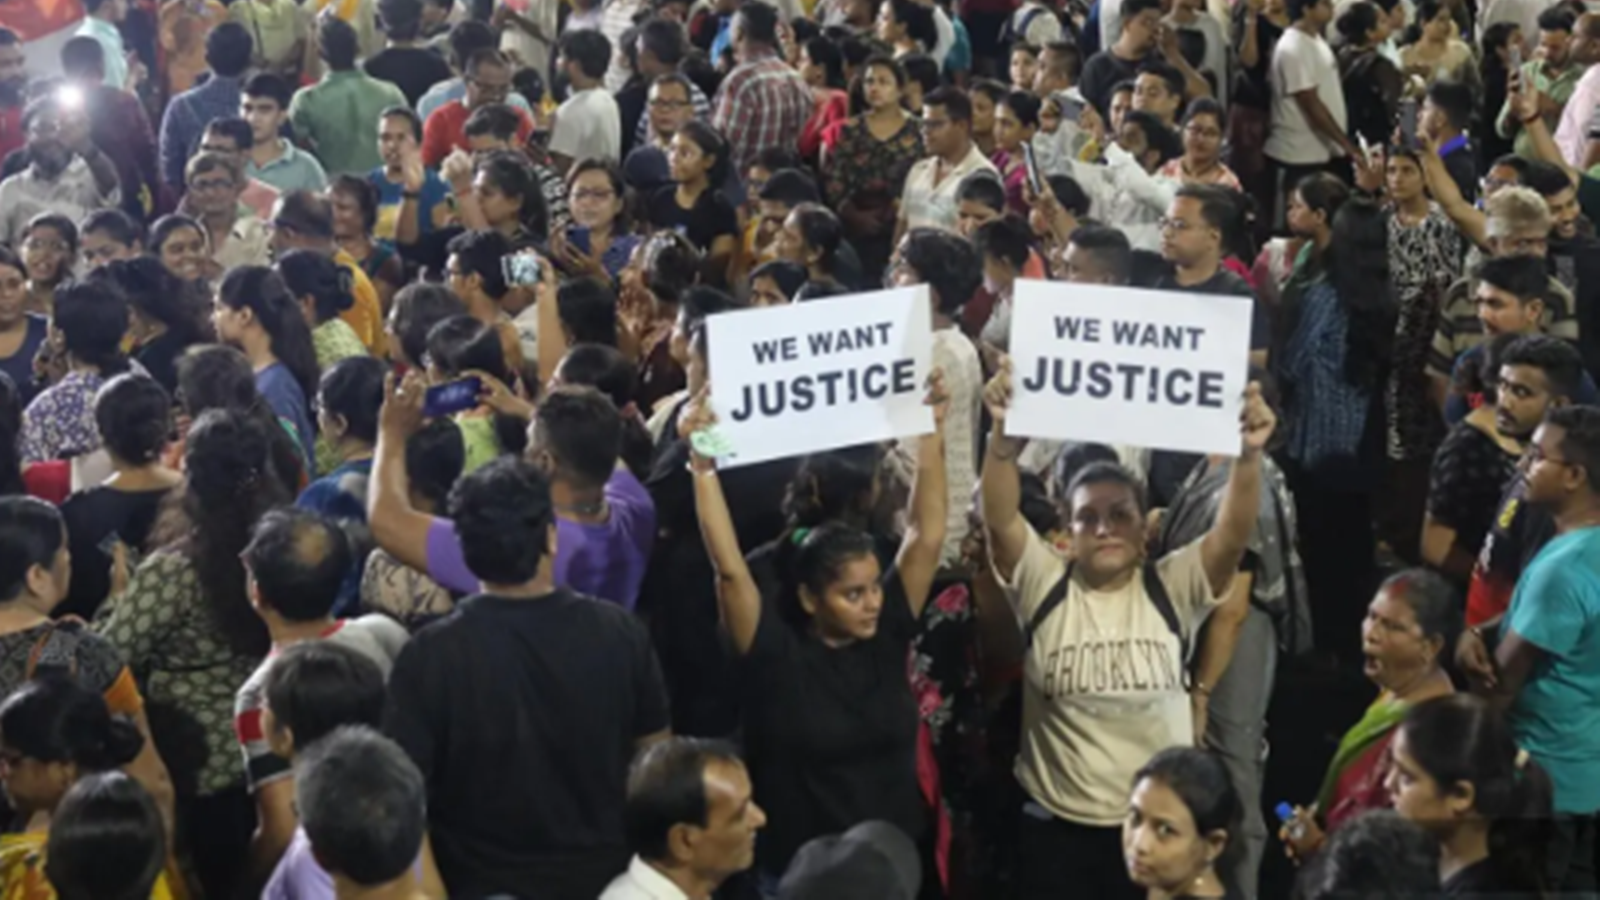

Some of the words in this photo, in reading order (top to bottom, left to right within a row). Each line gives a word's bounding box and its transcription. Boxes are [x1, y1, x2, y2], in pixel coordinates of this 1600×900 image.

[752, 337, 798, 364] WE
[807, 321, 892, 356] WANT
[1054, 316, 1100, 342] WE
[1112, 320, 1205, 351] WANT
[1043, 637, 1177, 700] BROOKLYN
